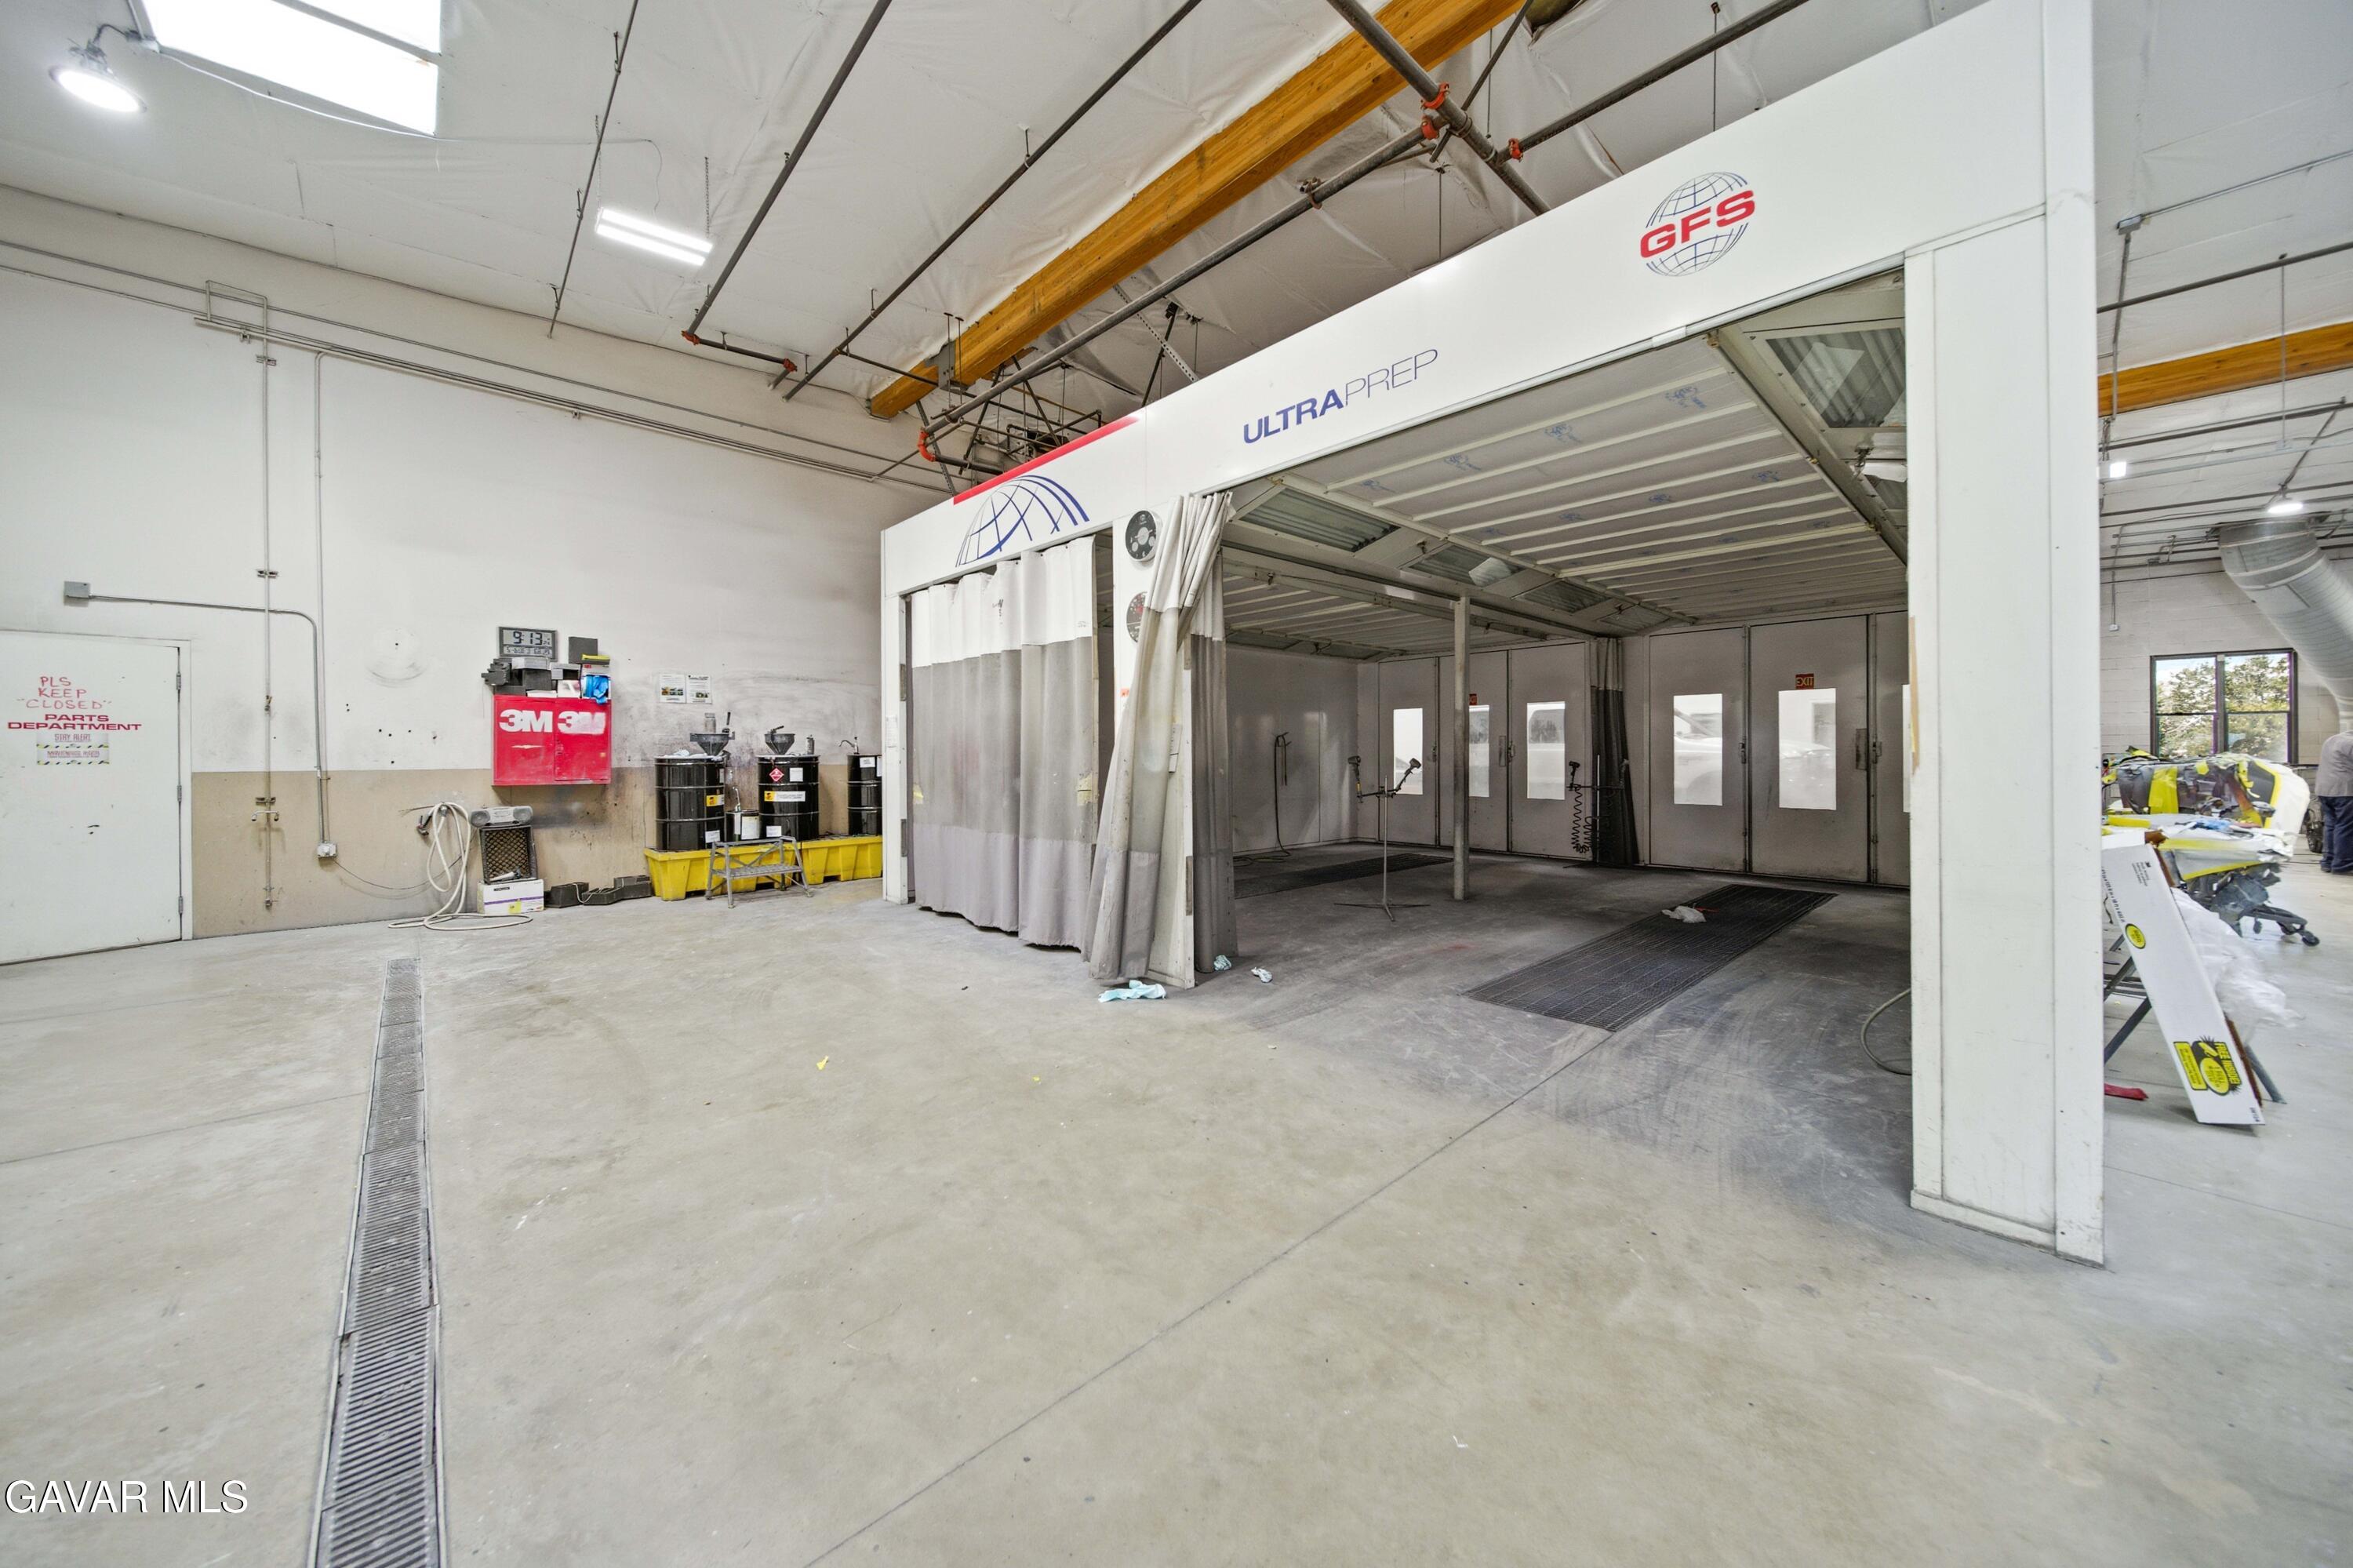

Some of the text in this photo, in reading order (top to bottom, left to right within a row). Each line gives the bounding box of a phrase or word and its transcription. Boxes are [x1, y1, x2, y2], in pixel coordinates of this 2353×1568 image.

[1640, 190, 1755, 258] GFS
[513, 631, 543, 645] 9:13
[40, 676, 71, 687] PLS
[38, 688, 87, 698] KEEP
[8, 722, 142, 730] DEPARTMENT
[499, 709, 553, 733] 3M
